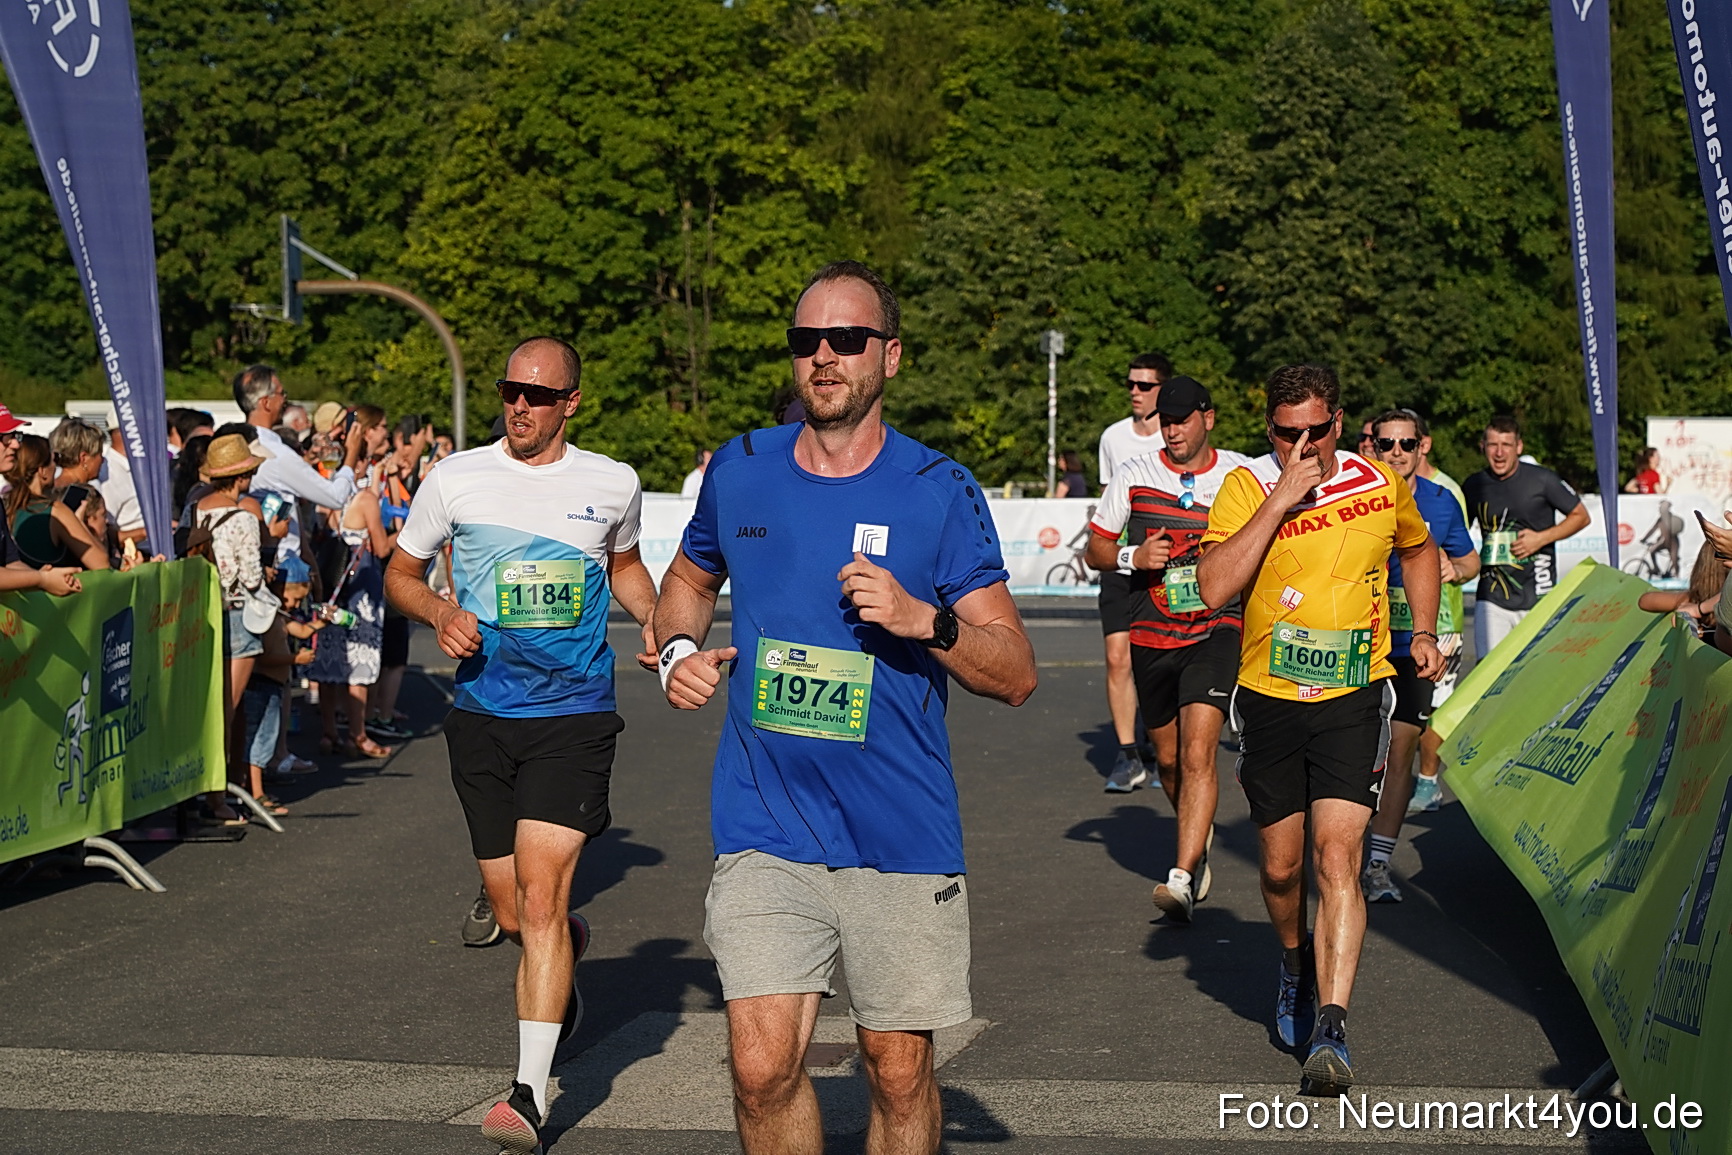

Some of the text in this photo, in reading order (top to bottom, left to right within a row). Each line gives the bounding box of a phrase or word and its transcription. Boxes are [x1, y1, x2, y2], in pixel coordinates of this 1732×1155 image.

[1278, 495, 1395, 540] MAX BÖGL
[736, 526, 767, 538] JAKO
[501, 592, 510, 615] RUN
[511, 583, 572, 606] 1184
[573, 586, 581, 617] 2022
[510, 607, 573, 616] Berweiler Björn
[783, 659, 819, 669] Firmenlauf
[1274, 646, 1283, 666] RUN
[1284, 644, 1337, 669] 1600
[1336, 653, 1347, 680] 2022
[1283, 662, 1304, 673] Beyer
[1306, 667, 1335, 678] Richard
[757, 679, 768, 711] RUN
[771, 672, 850, 711] 1974
[767, 703, 811, 720] Schmidt
[814, 710, 847, 724] David
[850, 688, 865, 729] 2022
[934, 881, 961, 905] PUMA
